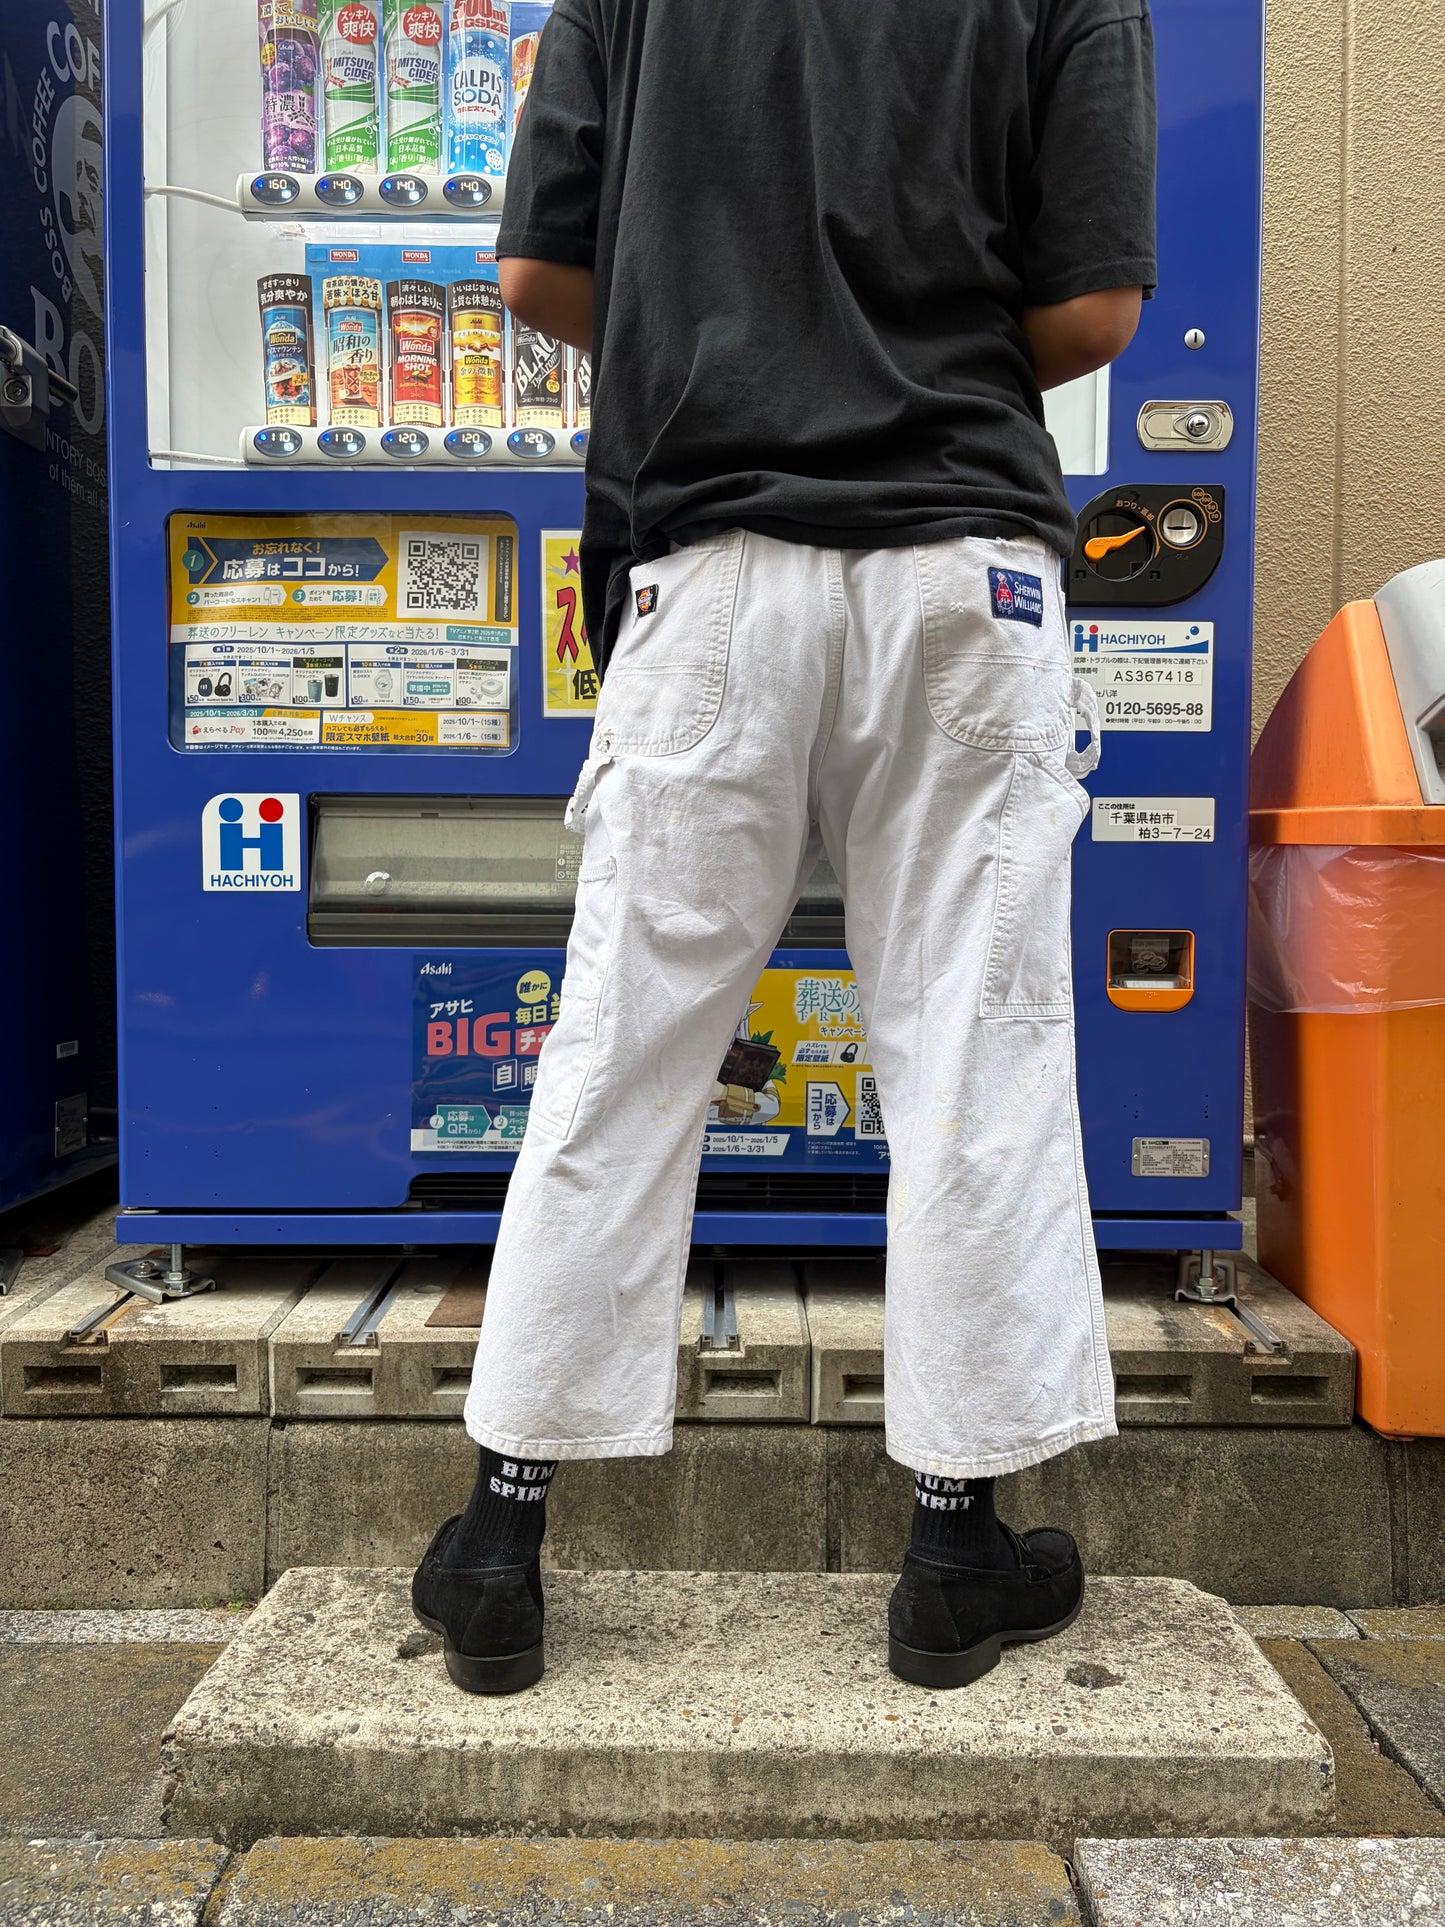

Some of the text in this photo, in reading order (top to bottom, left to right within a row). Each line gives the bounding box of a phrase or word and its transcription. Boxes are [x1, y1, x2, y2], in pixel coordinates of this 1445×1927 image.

[341, 10, 370, 21] スッキリ
[407, 11, 436, 22] スッキリ
[343, 21, 375, 38] 爽快
[408, 22, 440, 39] 爽快
[333, 57, 374, 71] MITSUYA
[398, 57, 439, 72] MITSUYA
[344, 67, 374, 81] CIDER
[408, 68, 438, 82] CIDER
[454, 70, 502, 94] CALPIS
[454, 88, 502, 110] SODA
[269, 179, 287, 190] 160
[333, 180, 351, 190] 140
[397, 180, 415, 191] 140
[461, 181, 479, 192] 140
[333, 251, 356, 259] WONDA
[260, 290, 308, 305] 気分爽やか
[390, 294, 443, 310] 朝のはじまりに
[270, 333, 295, 344] Wonda
[333, 334, 370, 354] 昭和の
[401, 340, 433, 353] Wonda
[347, 348, 373, 364] 香り
[398, 355, 437, 366] MORNING
[465, 356, 488, 365] Wonda
[404, 363, 431, 371] SHOT
[516, 331, 559, 397] BLAC
[272, 433, 290, 442] 110
[335, 433, 353, 442] 110
[399, 433, 417, 443] 120
[462, 433, 480, 443] 120
[525, 433, 543, 444] 120
[252, 542, 321, 555] お忘れなく!
[222, 556, 359, 580] 応募はココから!
[332, 589, 362, 602] 応募!
[557, 587, 587, 663] ス
[188, 626, 268, 640] 葬送のフリーレン
[1101, 634, 1166, 645] HACHIYOH
[1113, 670, 1193, 682] AS367418
[1106, 702, 1204, 716] 0120-5695-88
[329, 713, 367, 723] Wチャンス
[325, 732, 390, 743] 限定スマホ壁紙
[1110, 812, 1175, 825] 千葉県柏市
[211, 874, 293, 887] HACHIYOH
[420, 962, 452, 975] Asahi
[519, 981, 547, 995] 誰かに
[796, 979, 860, 1014] 葬送の
[430, 999, 473, 1019] アサヒ
[427, 1012, 510, 1057] BIG
[811, 1089, 823, 1129] ココから
[825, 1093, 838, 1126] 応募は
[447, 1111, 475, 1122] 応募は
[501, 1460, 556, 1481] BUM
